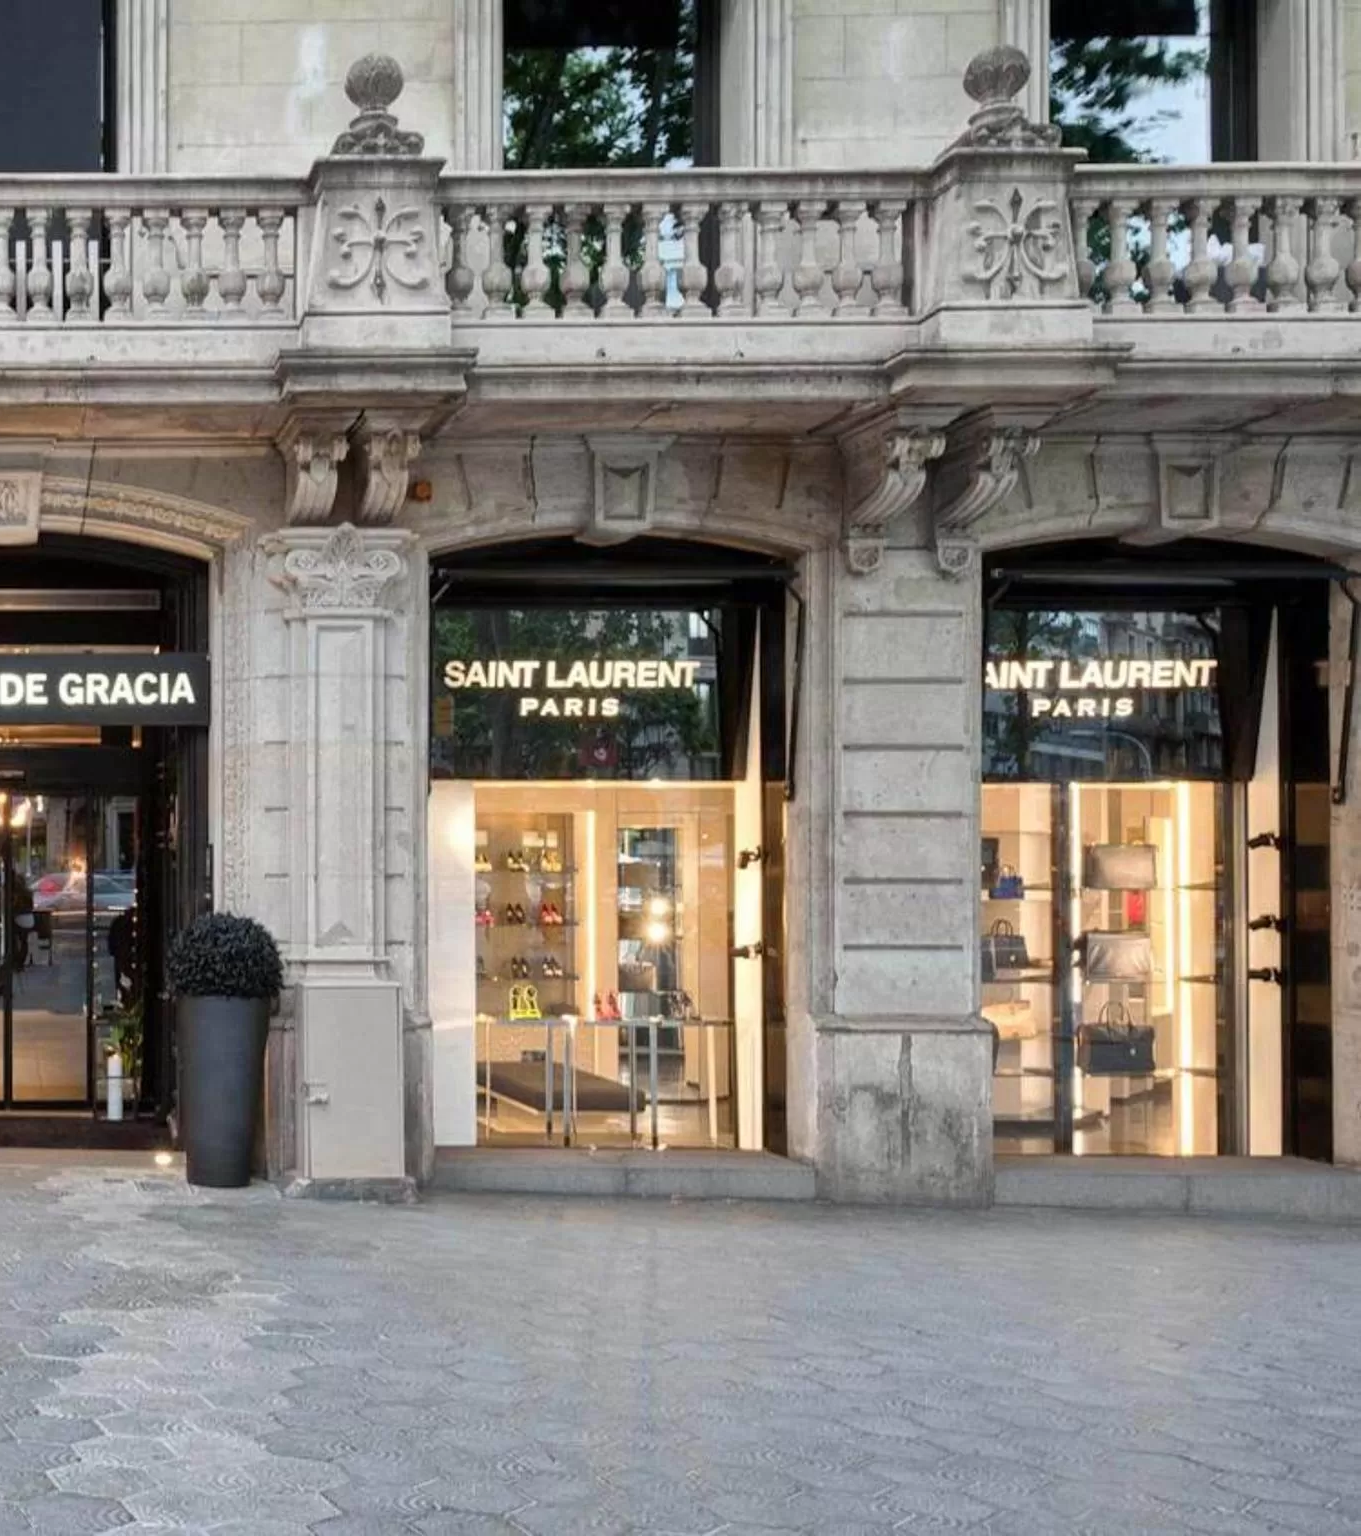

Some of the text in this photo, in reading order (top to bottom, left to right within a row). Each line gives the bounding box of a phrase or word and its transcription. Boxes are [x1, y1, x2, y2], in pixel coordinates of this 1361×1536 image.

[444, 660, 700, 688] SAINT LAURENT
[985, 659, 1218, 689] AINT LAURENT
[59, 672, 196, 706] GRACIA
[519, 698, 620, 717] PARIS
[1031, 698, 1134, 718] PARIS
